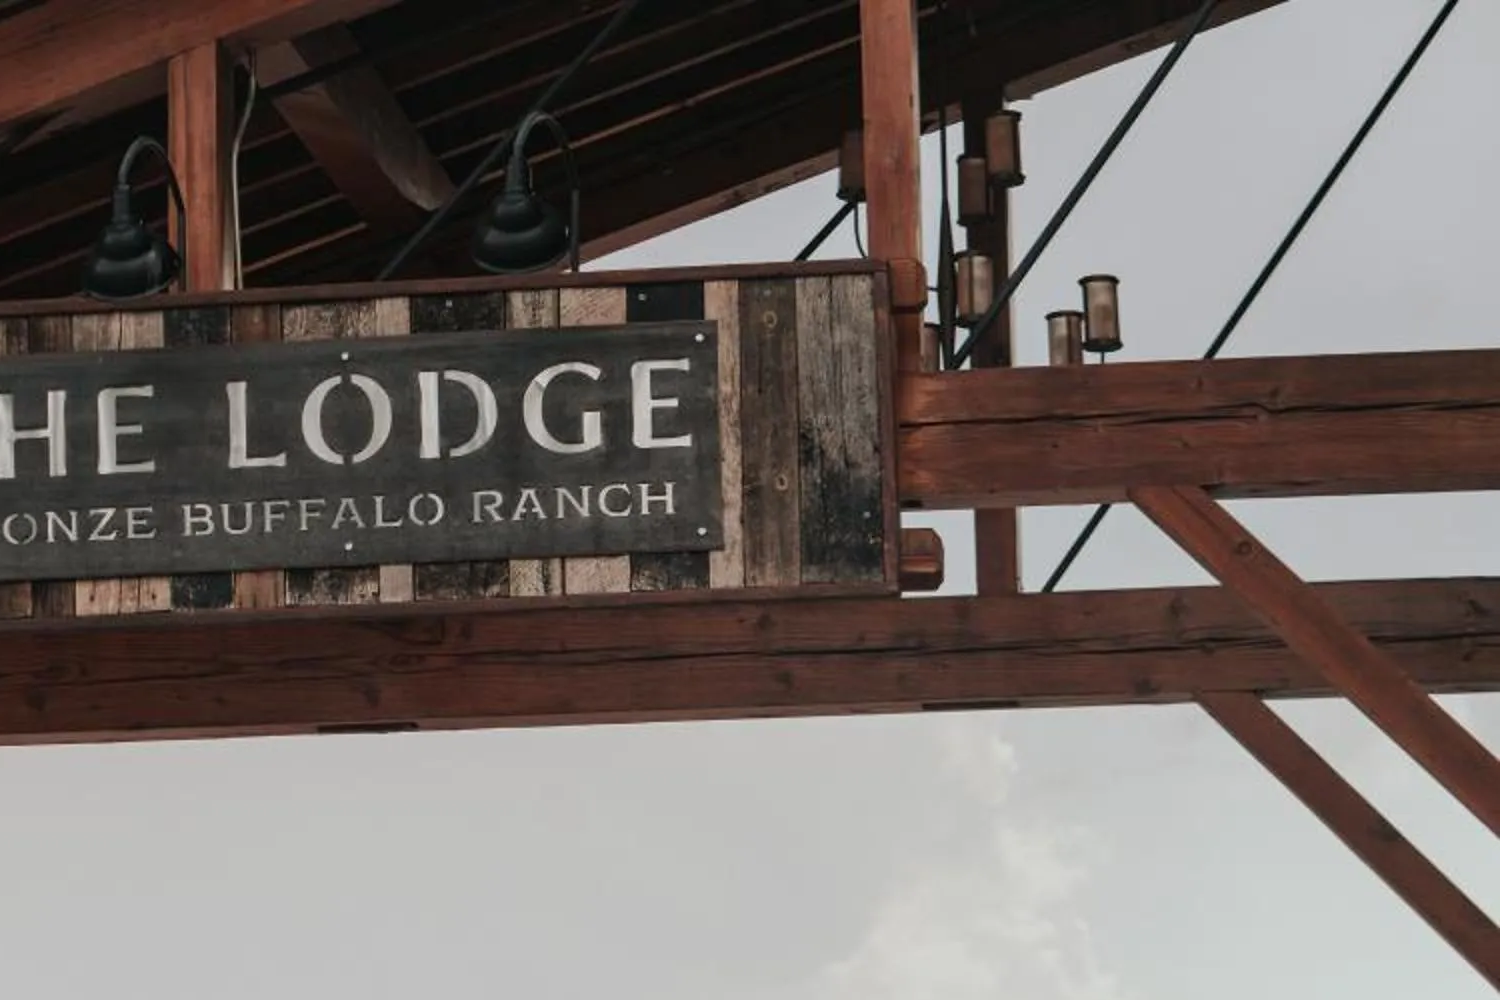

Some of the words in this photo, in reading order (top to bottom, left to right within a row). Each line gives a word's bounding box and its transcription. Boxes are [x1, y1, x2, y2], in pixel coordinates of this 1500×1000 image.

[225, 357, 694, 470] LODGE
[181, 492, 446, 537] BUFFALO
[471, 481, 678, 524] RANCH
